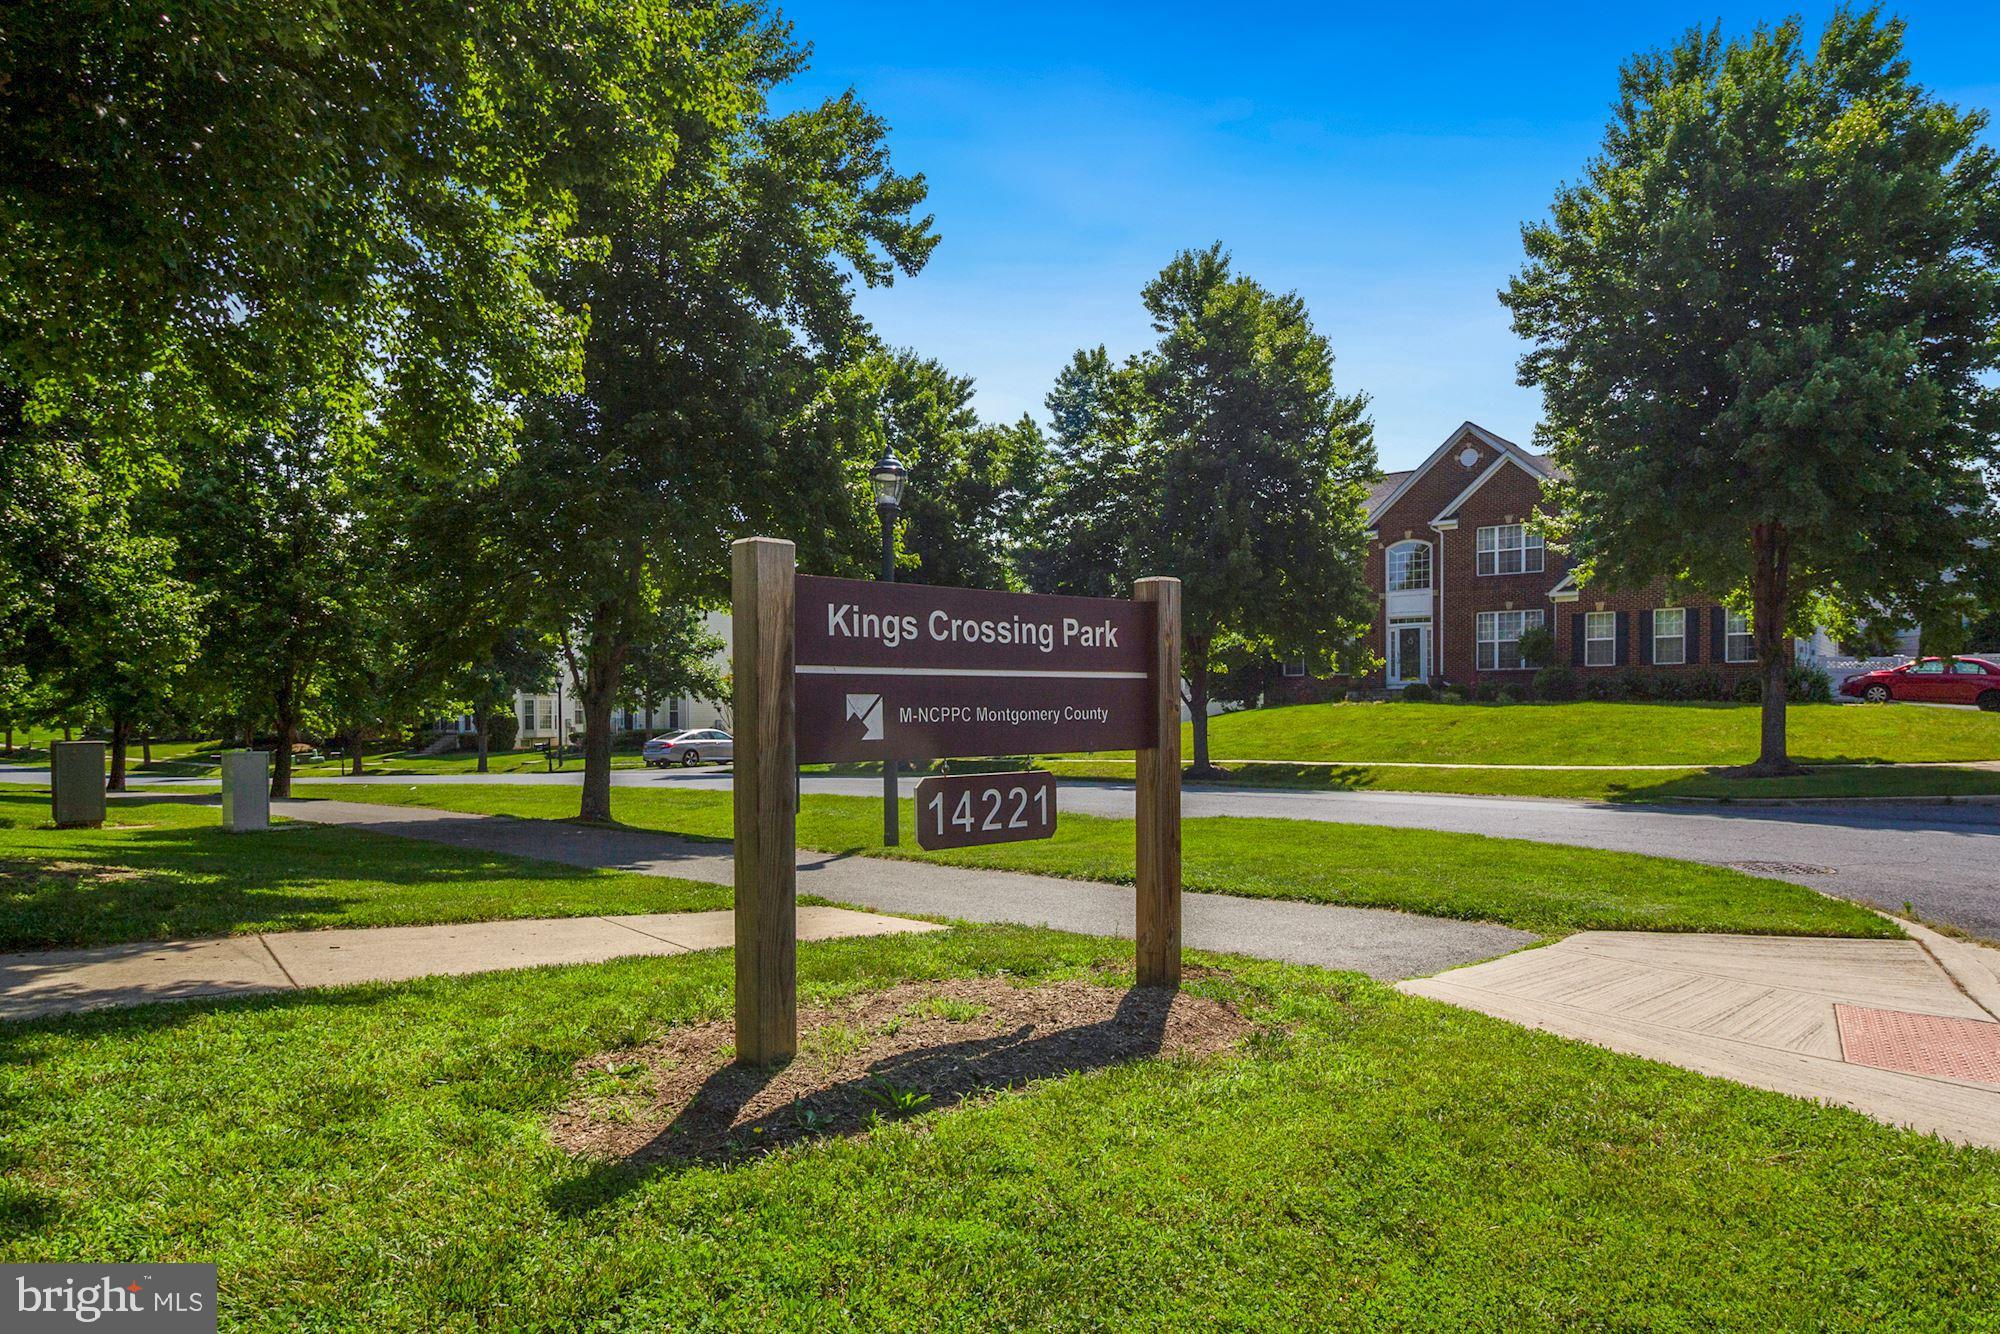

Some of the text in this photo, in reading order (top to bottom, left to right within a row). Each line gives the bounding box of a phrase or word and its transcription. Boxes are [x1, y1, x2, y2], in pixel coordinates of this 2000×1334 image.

[827, 602, 1119, 652] Kings Crossing Park
[899, 705, 1109, 725] M-NCPPC Montgomery County
[928, 784, 1048, 836] 14221
